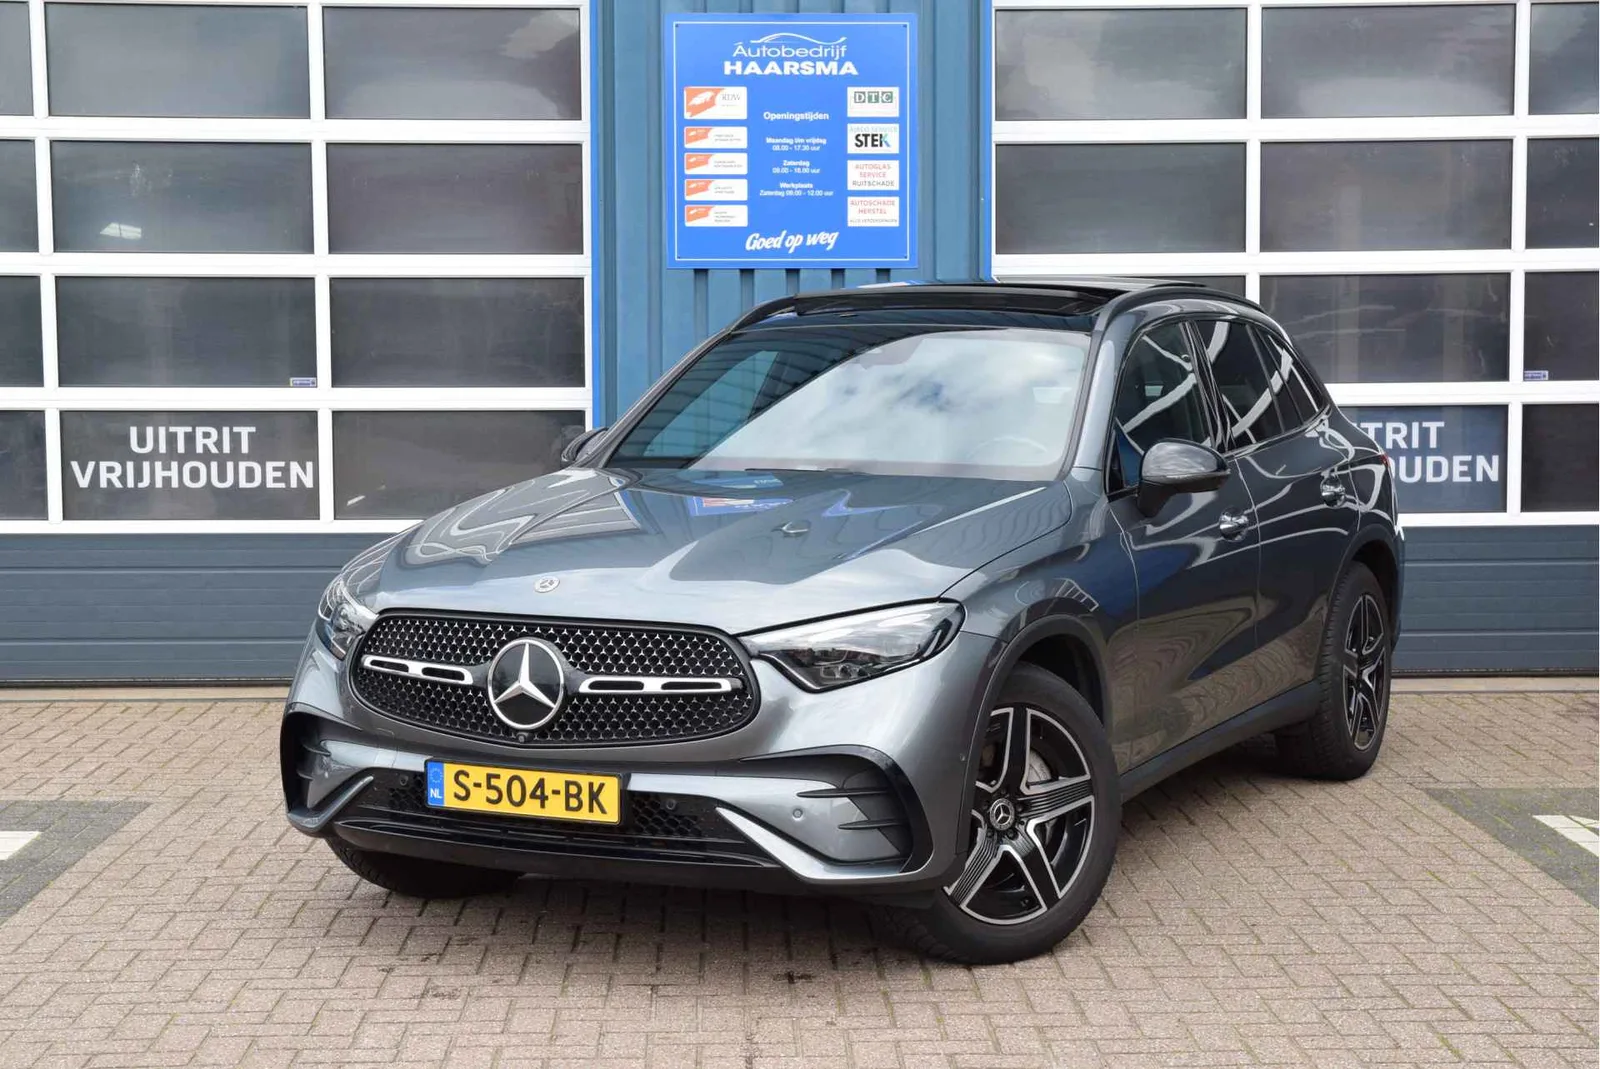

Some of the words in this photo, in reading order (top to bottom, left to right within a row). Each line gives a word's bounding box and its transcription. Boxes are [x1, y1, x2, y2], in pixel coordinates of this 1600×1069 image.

[732, 44, 847, 60] Autobedrijf
[723, 60, 859, 75] HAARSMA
[854, 91, 893, 103] DTC
[763, 111, 829, 121] Openingstijden
[766, 137, 794, 145] Maandag
[806, 137, 827, 145] vrijdag
[854, 133, 891, 148] STEK
[783, 160, 810, 168] Zaterdag
[745, 229, 787, 251] Goed
[785, 234, 803, 254] op
[806, 231, 840, 251] weg
[129, 426, 256, 454] UITRIT
[1352, 421, 1445, 449] TRIT
[70, 461, 314, 489] VRIJHOUDEN
[430, 789, 442, 799] NL
[453, 770, 608, 815] S-504-BK
